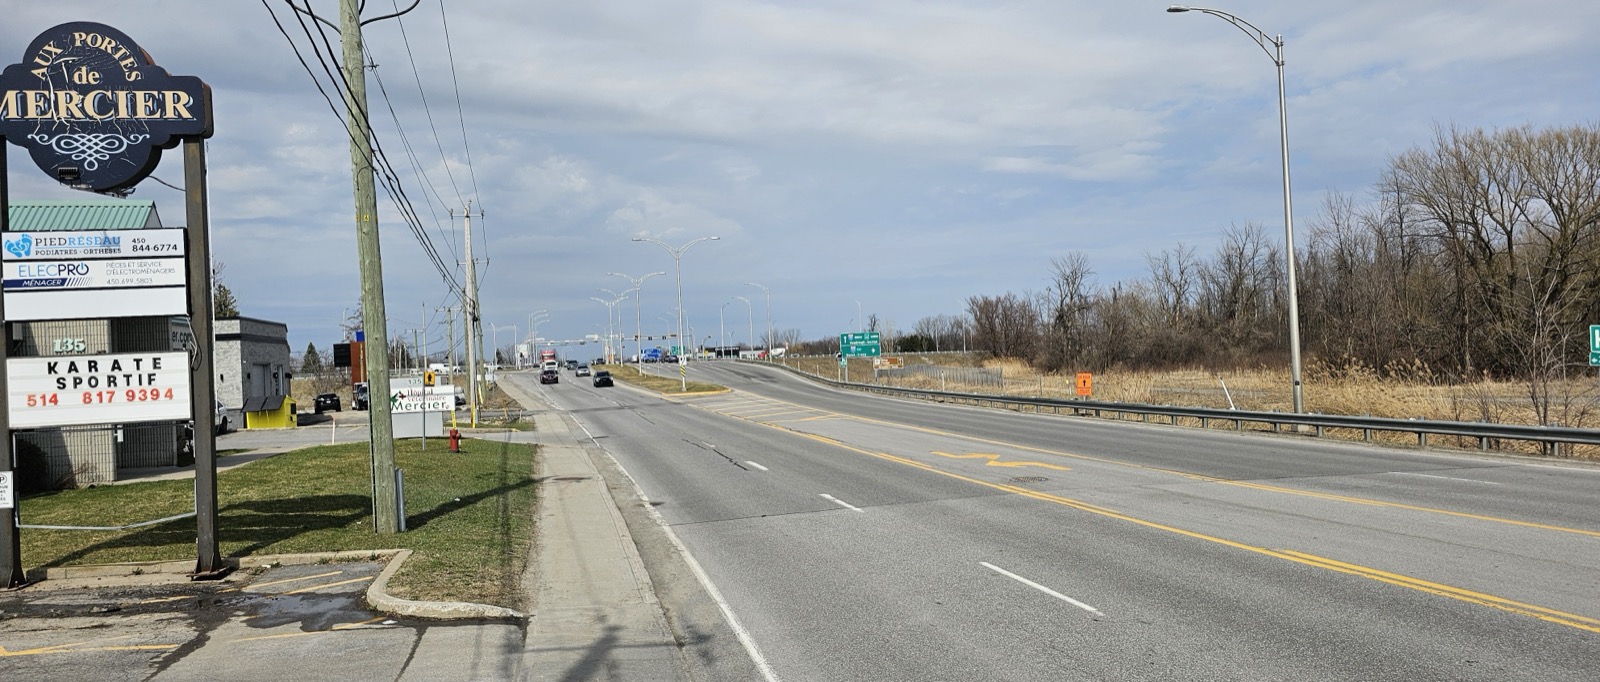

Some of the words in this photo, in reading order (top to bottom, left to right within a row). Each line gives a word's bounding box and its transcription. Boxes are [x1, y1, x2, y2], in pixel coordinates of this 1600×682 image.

[31, 40, 64, 81] AUX
[73, 31, 142, 82] PORTES
[73, 66, 101, 85] de
[35, 236, 121, 247] PIEDRÉSEAU
[18, 262, 90, 277] ELECPRO
[53, 337, 86, 352] 135
[47, 357, 162, 375] KARATE
[56, 373, 157, 390] SPORTIF
[27, 393, 59, 407] 514
[82, 391, 116, 404] 817
[125, 388, 174, 402] 9394
[391, 401, 447, 411] Mercier
